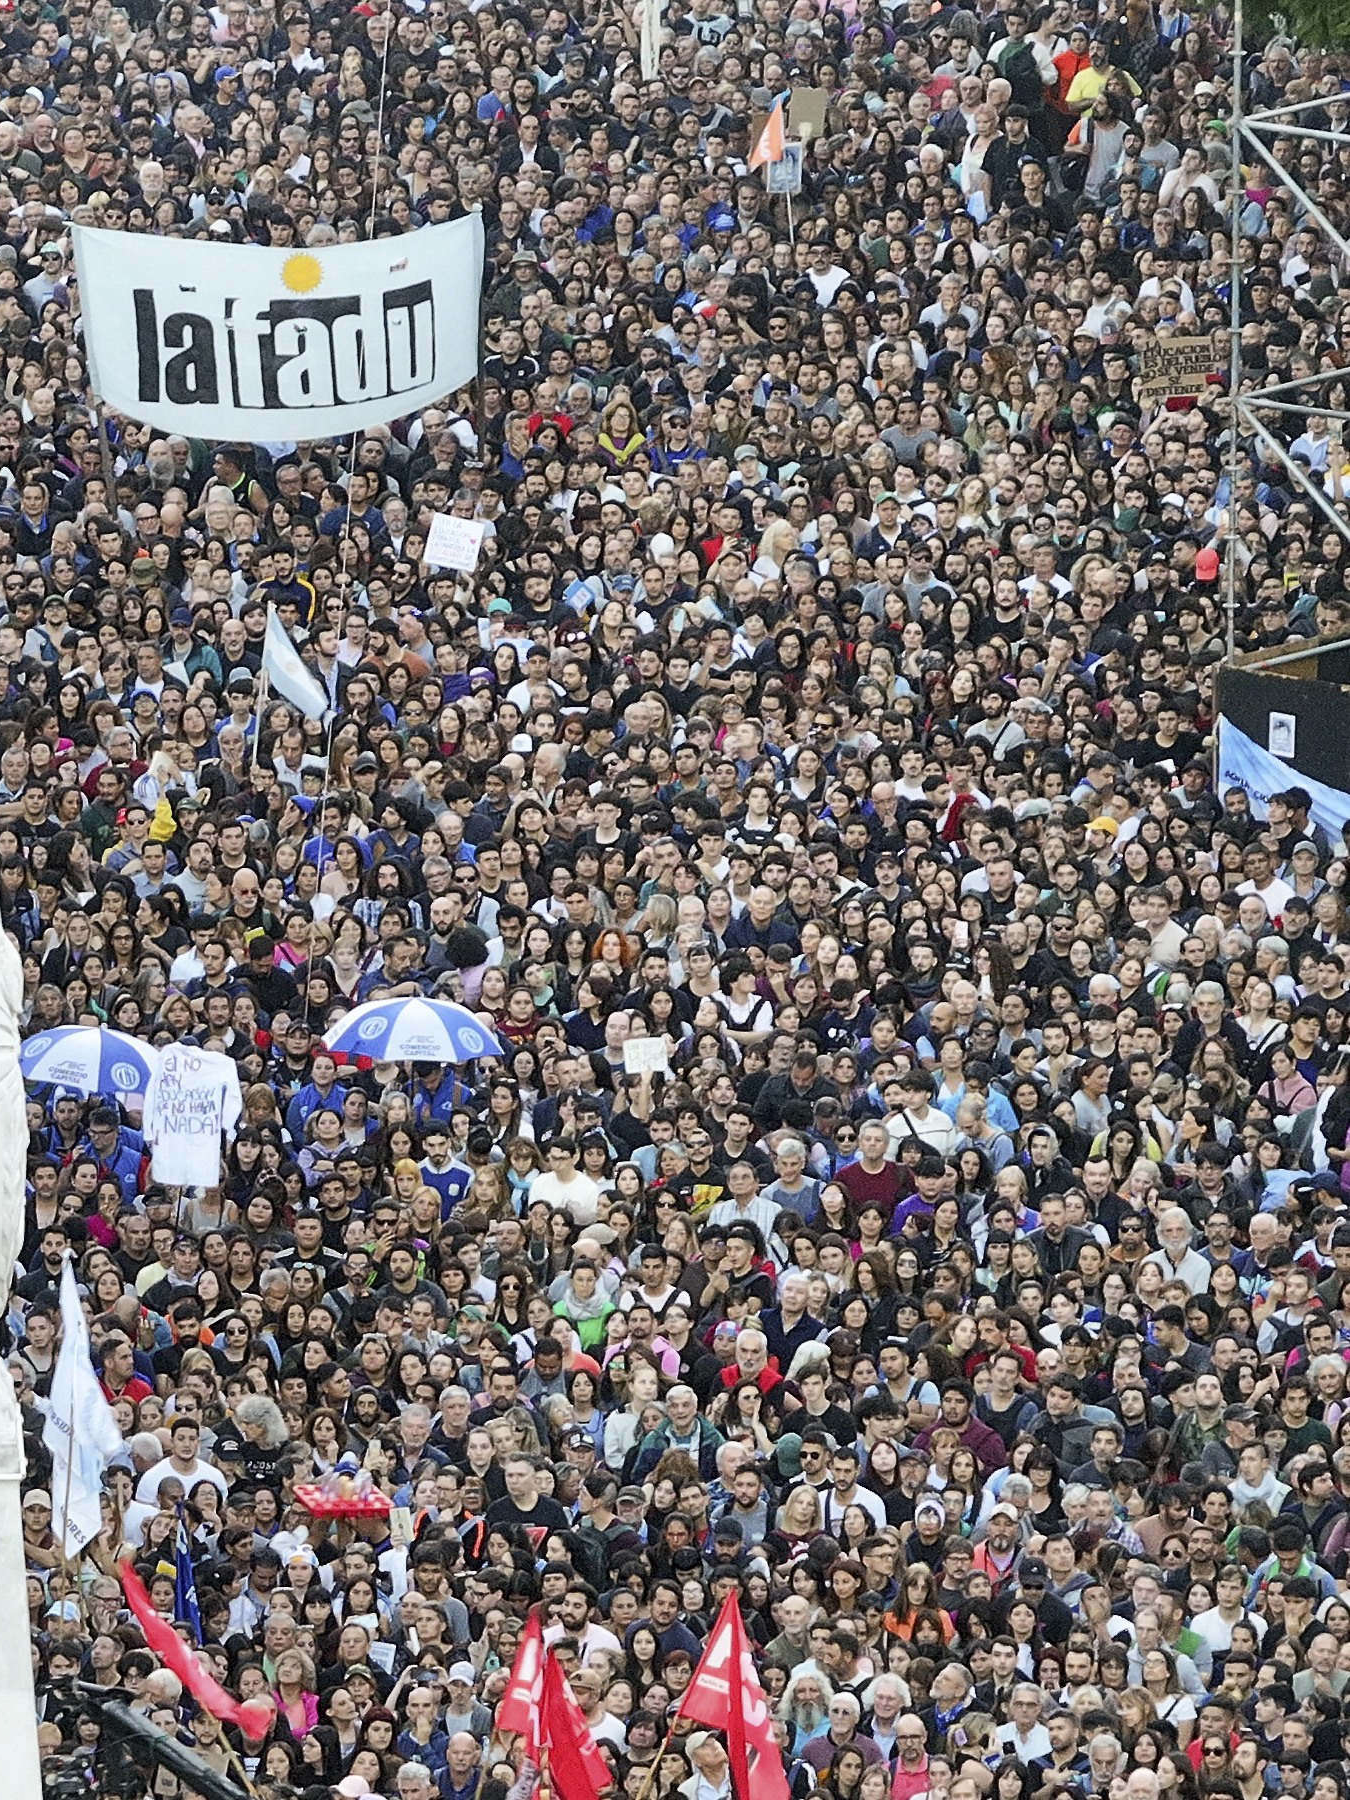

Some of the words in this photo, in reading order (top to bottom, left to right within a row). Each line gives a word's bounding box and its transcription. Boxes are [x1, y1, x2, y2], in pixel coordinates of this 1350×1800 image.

[183, 1058, 202, 1072] NO
[48, 1066, 88, 1079] COMERCIO
[51, 1073, 80, 1084] CAPITAL
[164, 1114, 220, 1136] NADA!
